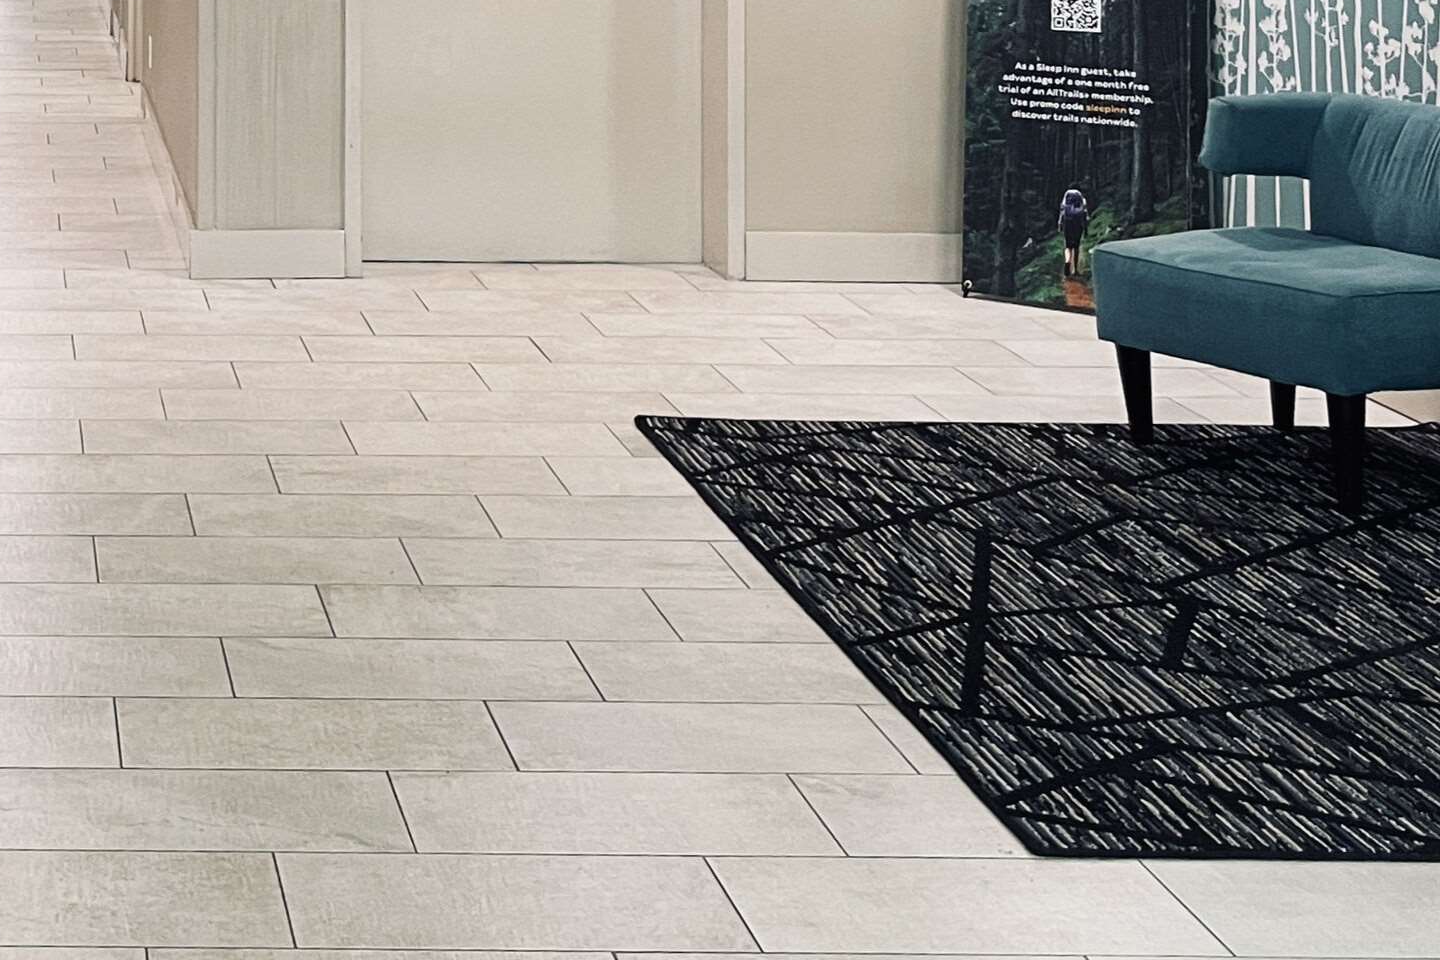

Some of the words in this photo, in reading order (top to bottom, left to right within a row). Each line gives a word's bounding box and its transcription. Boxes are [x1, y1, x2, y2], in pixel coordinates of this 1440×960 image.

[1014, 62, 1027, 71] As
[1036, 63, 1062, 73] Sleep
[1063, 65, 1080, 73] Inn
[1080, 66, 1113, 76] guest,
[1113, 68, 1138, 78] take
[998, 85, 1020, 95] trial
[1020, 86, 1032, 95] of
[1032, 88, 1046, 96] an
[1002, 74, 1054, 85] advantage
[1054, 77, 1066, 85] of
[1074, 79, 1093, 87] one
[1094, 81, 1128, 90] month
[1128, 82, 1150, 92] free
[1010, 97, 1029, 107] Use
[1029, 100, 1060, 109] promo
[1060, 101, 1085, 111] code
[1128, 107, 1142, 116] to
[1011, 109, 1053, 121] discover
[1053, 113, 1080, 123] trails
[1080, 116, 1139, 128] nationwide.
